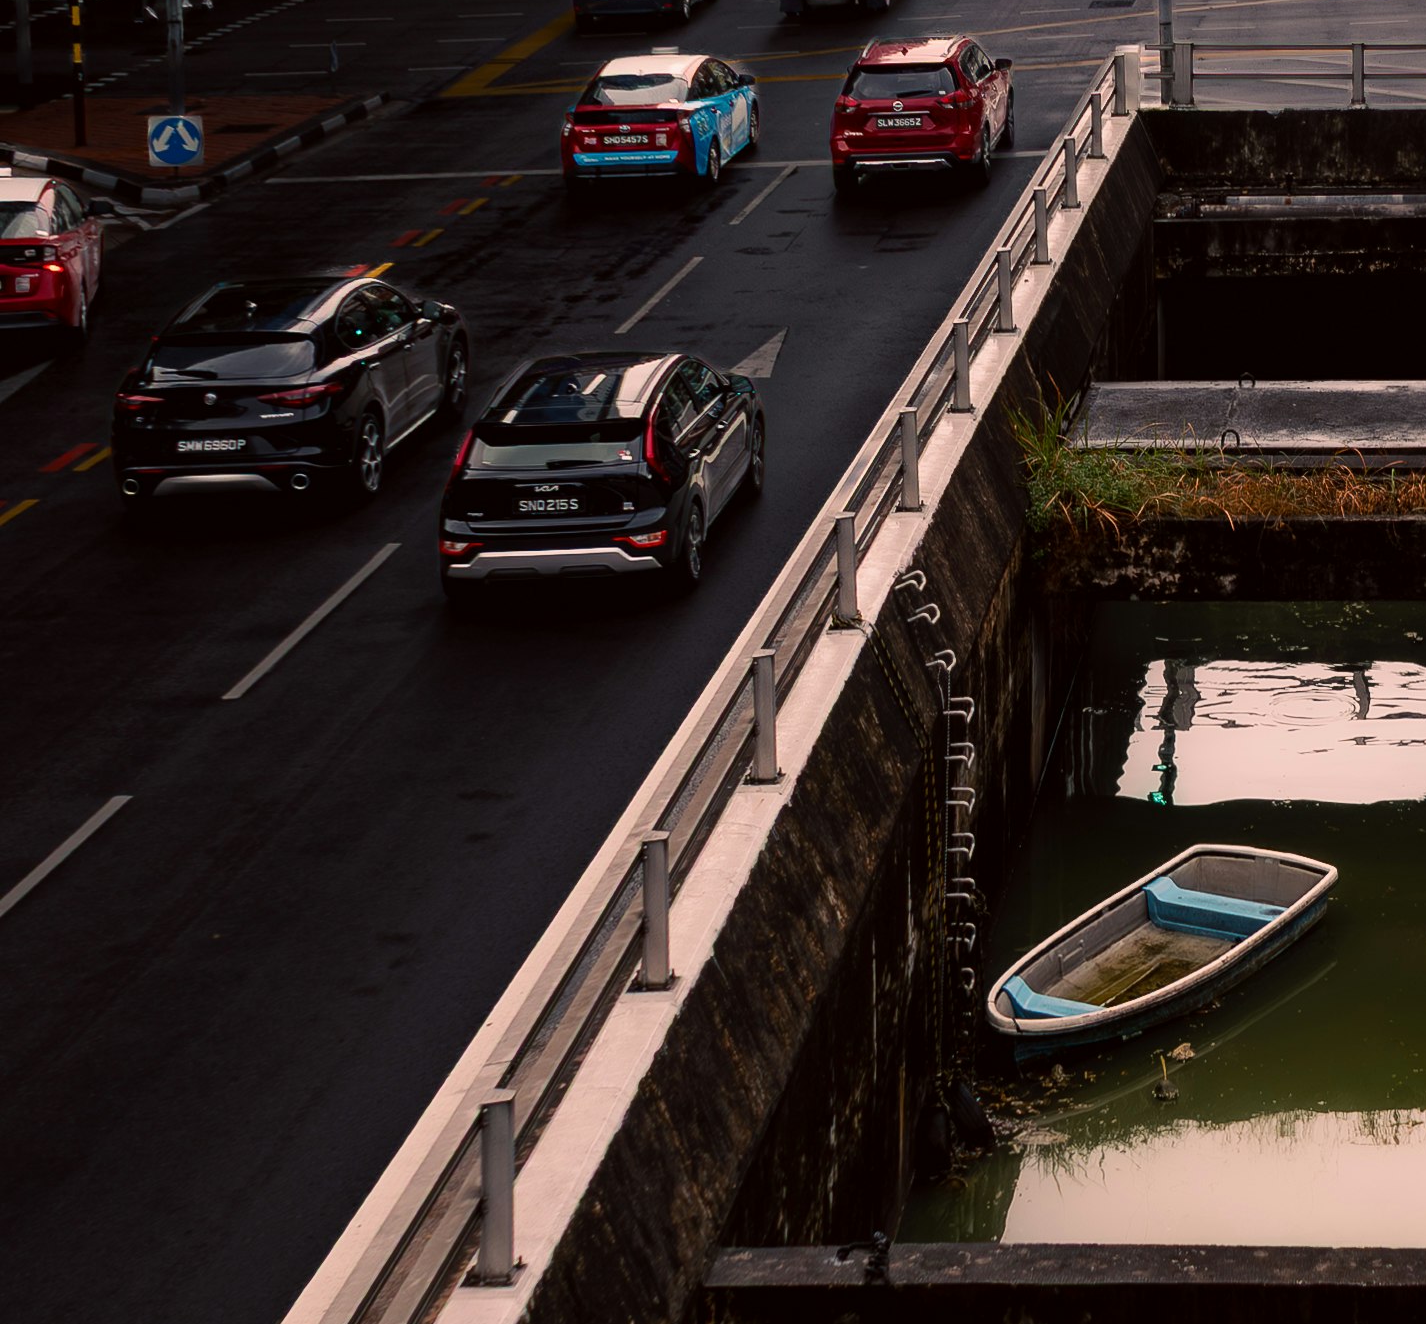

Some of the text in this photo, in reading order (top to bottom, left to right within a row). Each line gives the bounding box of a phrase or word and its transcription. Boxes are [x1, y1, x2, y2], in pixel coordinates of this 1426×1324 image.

[877, 117, 922, 128] SLW3665Z
[603, 134, 649, 145] SHD5457S
[177, 438, 247, 452] SMW6960P
[518, 498, 580, 512] SNQ215S
